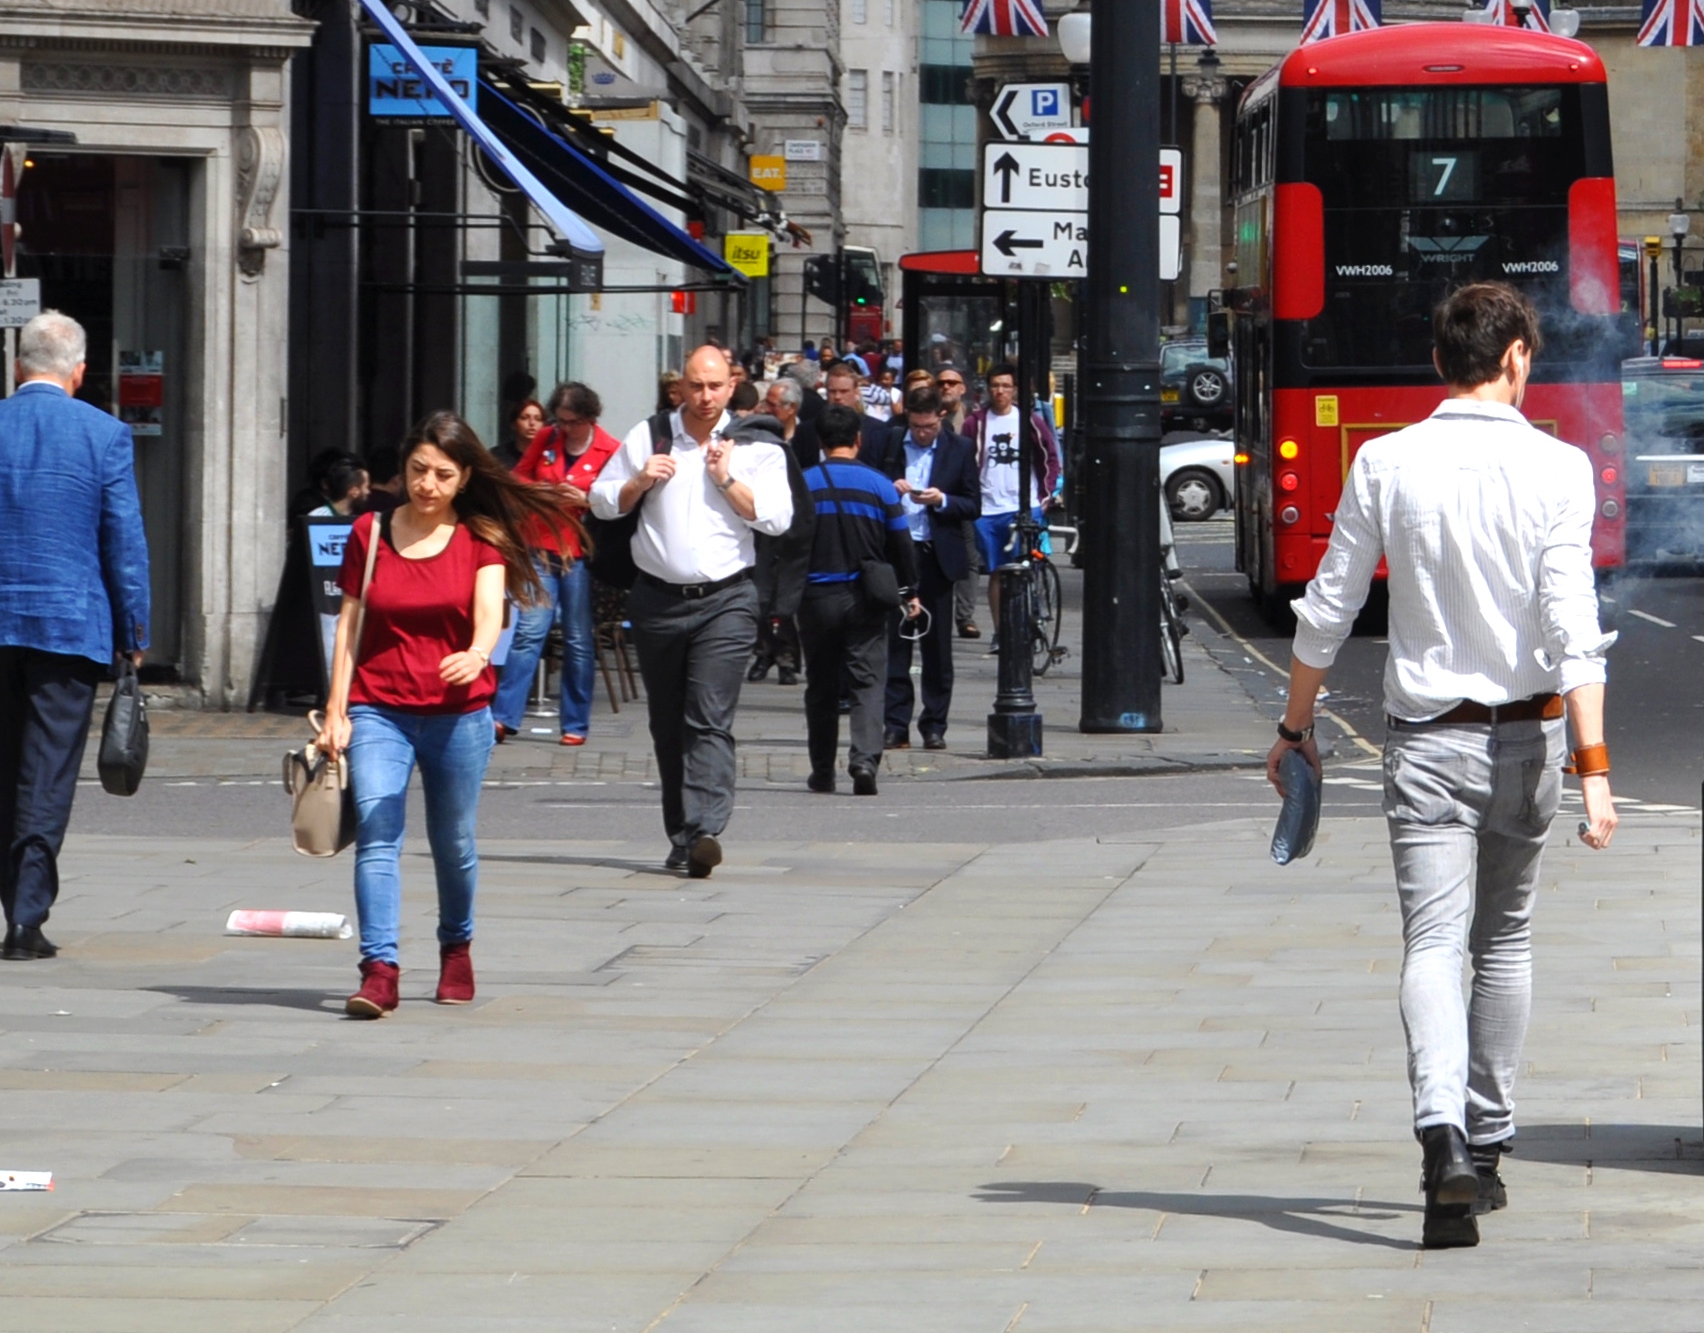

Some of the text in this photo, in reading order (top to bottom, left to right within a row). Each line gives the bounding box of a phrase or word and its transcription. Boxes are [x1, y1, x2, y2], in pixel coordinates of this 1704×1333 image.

[1036, 91, 1053, 114] P
[1047, 120, 1068, 128] Street
[752, 168, 782, 178] EAT.
[1431, 157, 1457, 196] 7
[1053, 221, 1088, 241] Ma
[732, 245, 761, 260] itsu
[1067, 249, 1087, 269] A
[1420, 253, 1476, 263] WRIGHT
[1335, 265, 1393, 277] VWH2006
[1502, 261, 1559, 274] VWH2006
[318, 542, 347, 556] NE
